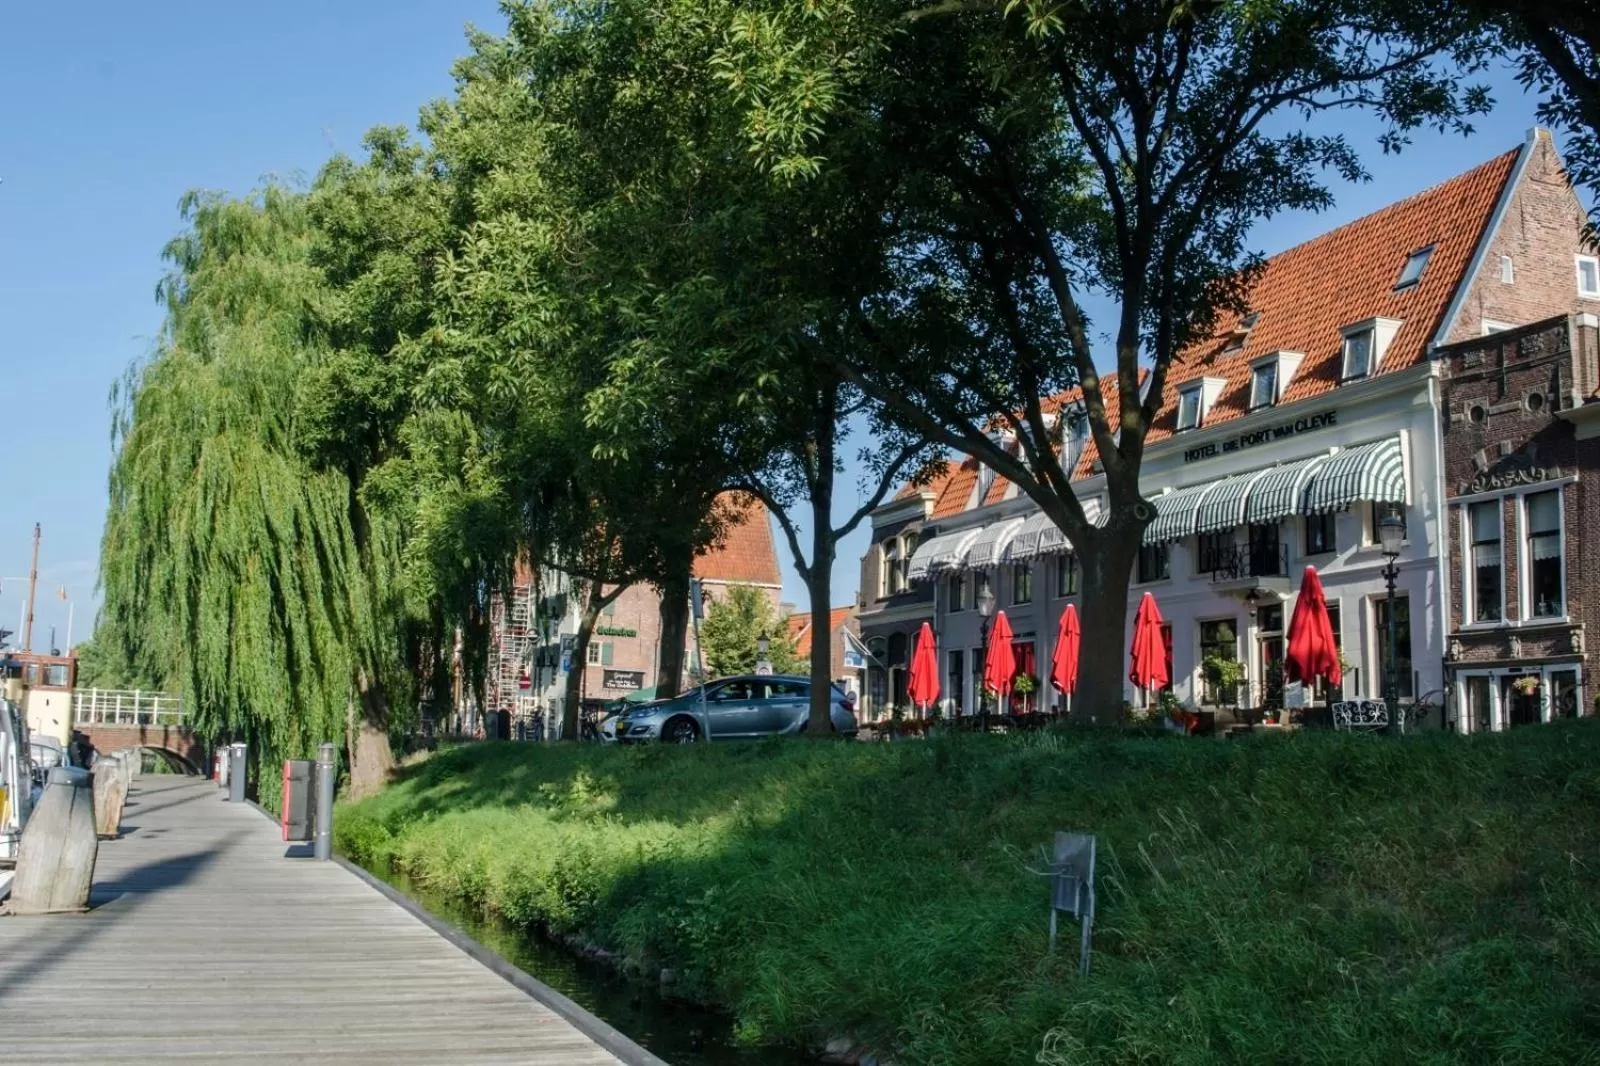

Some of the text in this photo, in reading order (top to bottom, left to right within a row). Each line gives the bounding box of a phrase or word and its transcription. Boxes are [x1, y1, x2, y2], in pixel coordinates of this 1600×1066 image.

[1185, 444, 1219, 462] HOTEL
[1240, 428, 1273, 448] PORT
[1273, 424, 1294, 438] VAN
[1294, 410, 1337, 433] CLEVE
